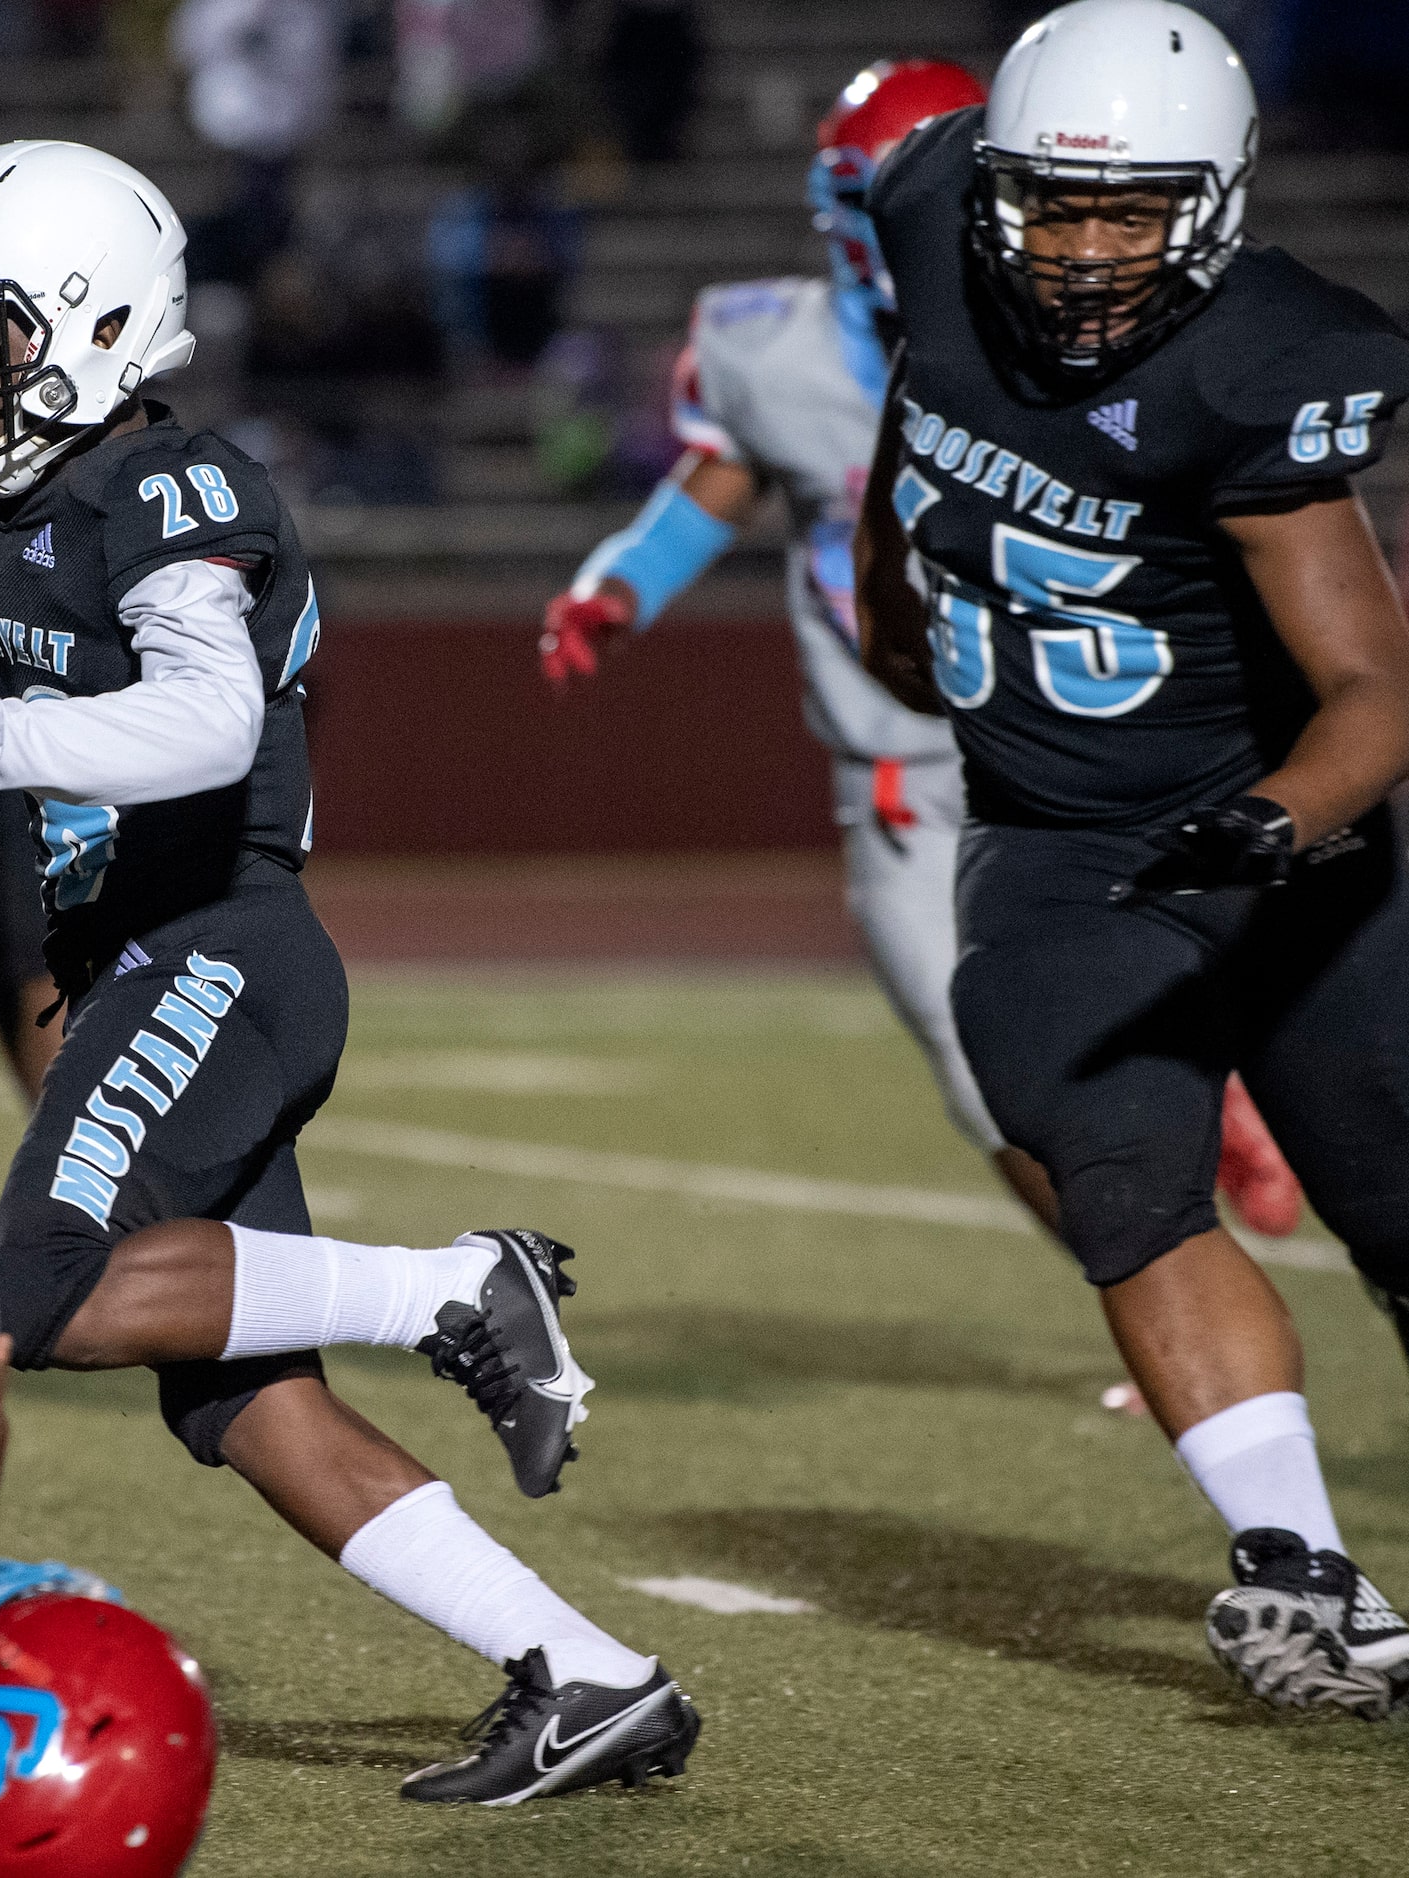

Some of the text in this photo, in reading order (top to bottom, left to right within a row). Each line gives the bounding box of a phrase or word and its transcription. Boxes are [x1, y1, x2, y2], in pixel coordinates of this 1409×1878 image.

[1288, 391, 1385, 463] 65
[138, 464, 239, 539] 28
[22, 546, 57, 569] adidas
[48, 949, 246, 1233] MUSTANGS
